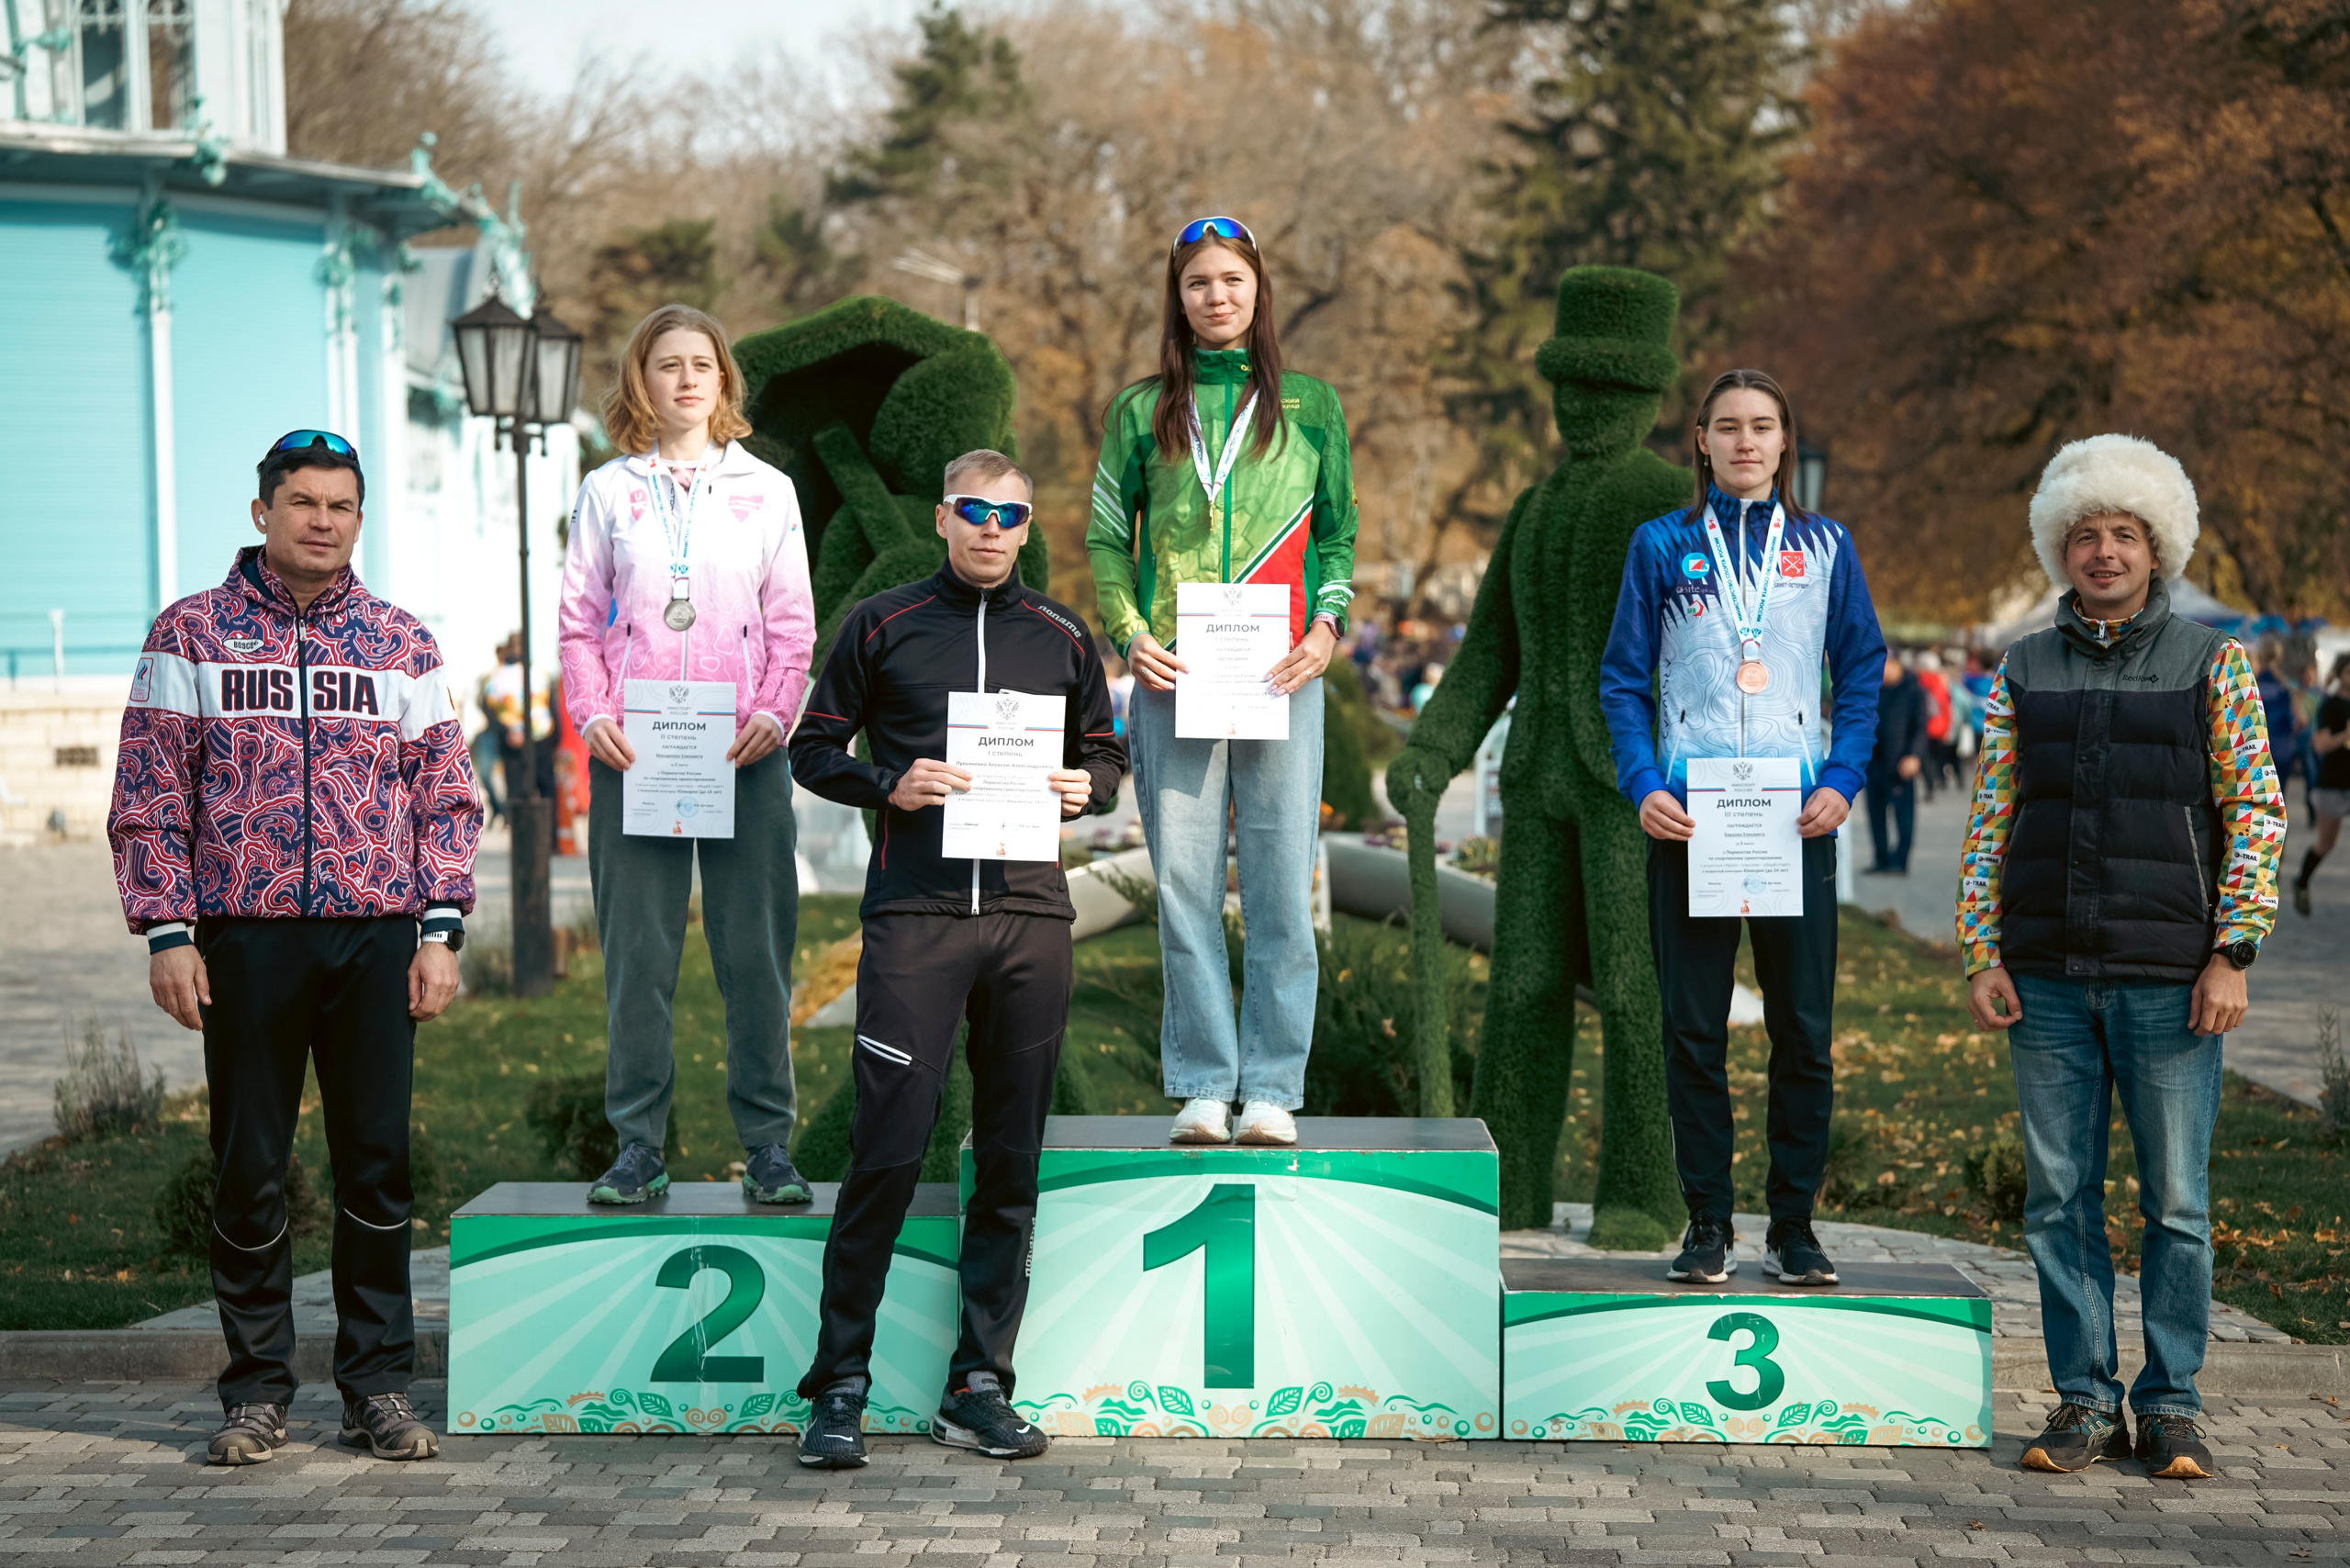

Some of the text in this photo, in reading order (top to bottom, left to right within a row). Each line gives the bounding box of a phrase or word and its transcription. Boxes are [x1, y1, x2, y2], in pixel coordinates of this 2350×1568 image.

[1714, 536, 1743, 622] МИНИСТЕРСТВО СПОРТА РОССИИ
[1755, 535, 1777, 622] МИНИСТЕРСТВО СПОРТА РОССИИ
[1037, 605, 1081, 638] noname
[1206, 624, 1259, 633] ДИПЛОМ
[234, 641, 254, 649] BOSCO
[221, 668, 379, 715] RUSSIA
[653, 722, 706, 731] ДИПЛОМ
[979, 737, 1034, 746] ДИПЛОМ
[1717, 799, 1771, 809] ДИПЛОМ
[1143, 1183, 1255, 1388] 1
[650, 1244, 765, 1382] 2
[1706, 1312, 1785, 1410] 3
